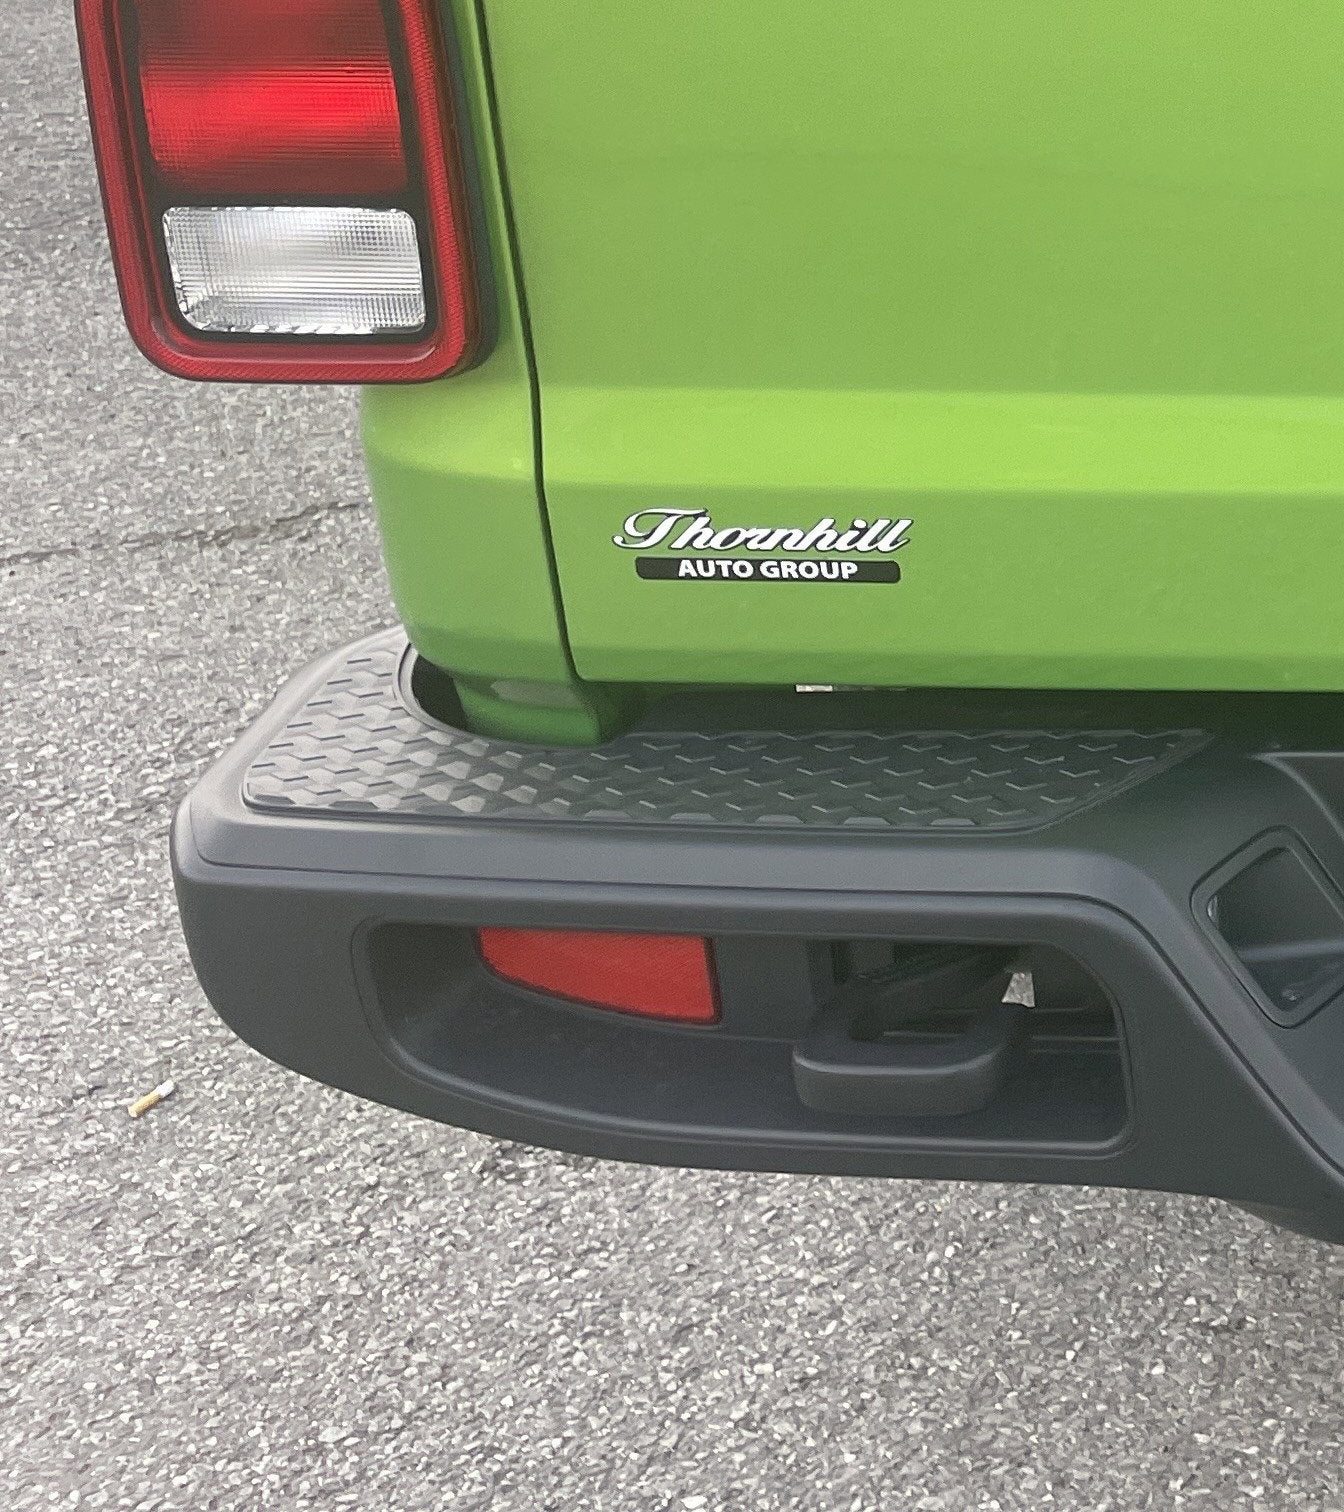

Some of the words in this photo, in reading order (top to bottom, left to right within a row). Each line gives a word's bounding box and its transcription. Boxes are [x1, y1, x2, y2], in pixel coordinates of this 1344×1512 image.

[612, 507, 913, 554] Thornhill
[677, 558, 754, 579] AUTO
[759, 559, 859, 581] GROUP
